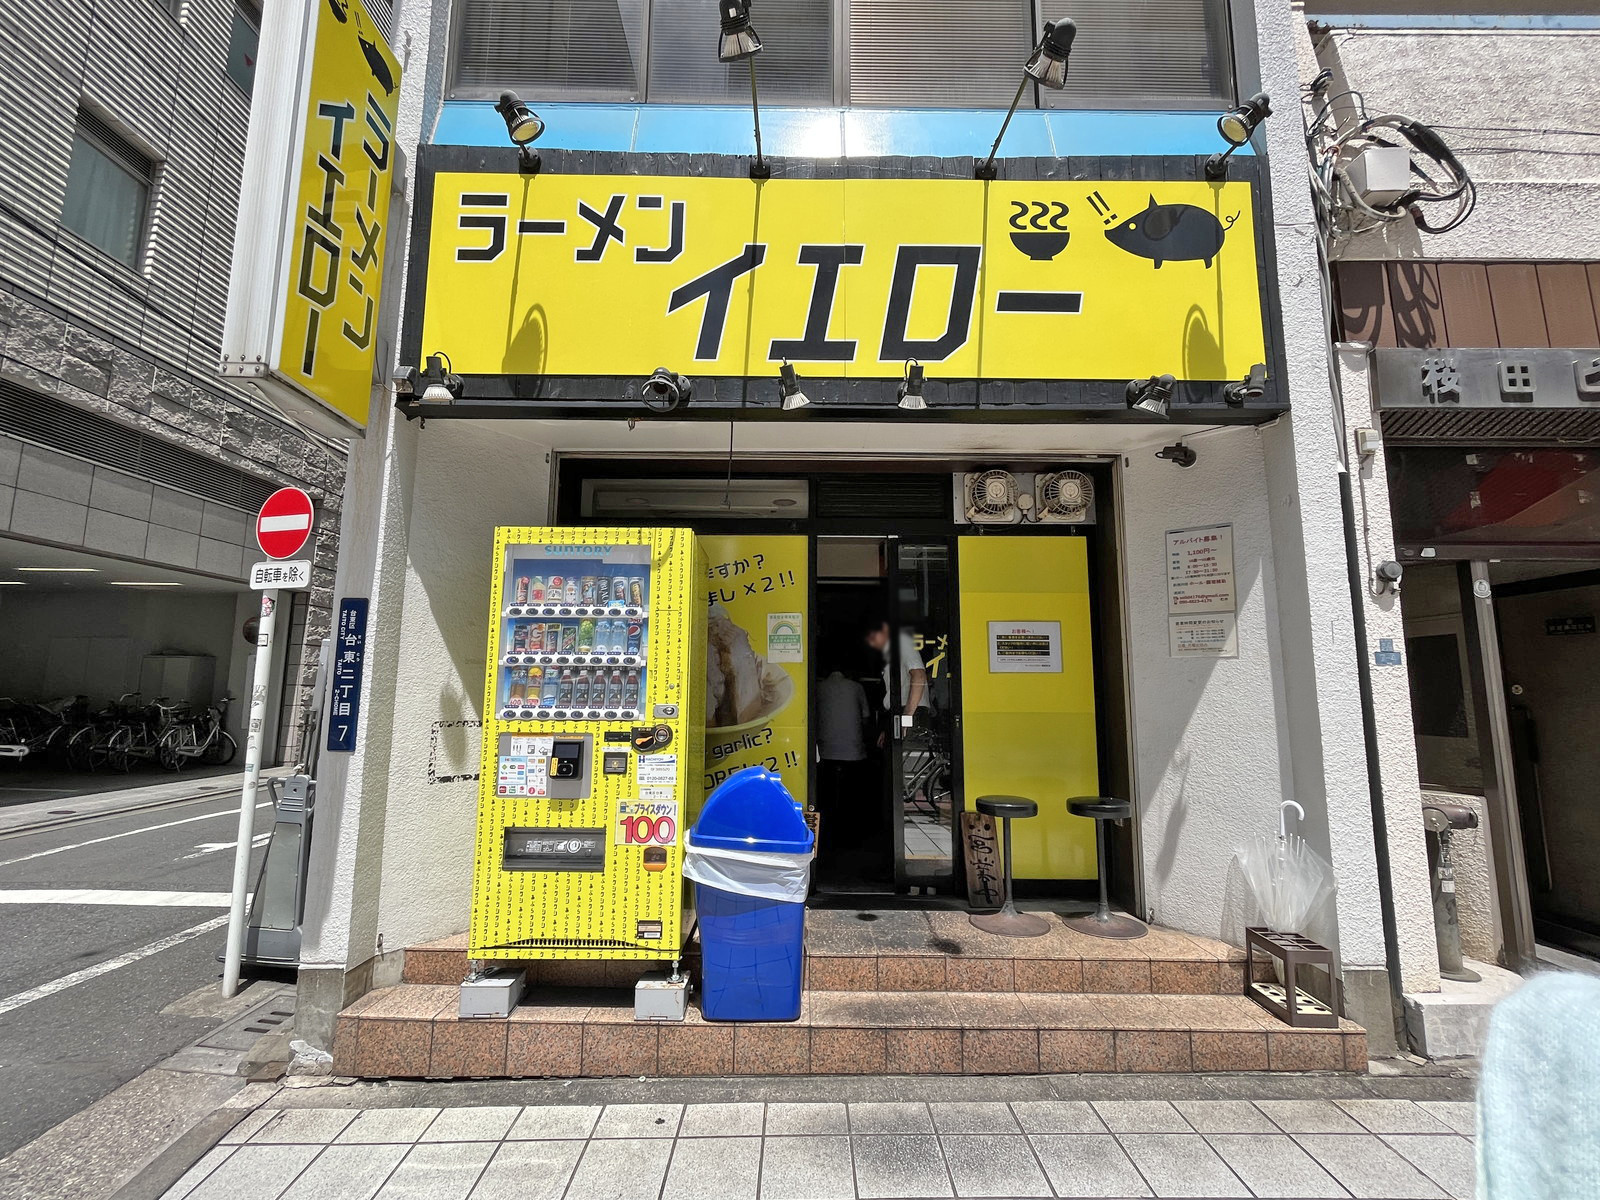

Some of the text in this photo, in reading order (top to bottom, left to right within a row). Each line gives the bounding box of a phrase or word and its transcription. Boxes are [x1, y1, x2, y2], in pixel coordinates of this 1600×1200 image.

[343, 89, 391, 351] ラーメン
[455, 192, 686, 264] ラーメン
[296, 99, 355, 377] イエロー
[667, 243, 1084, 363] イエロー
[544, 545, 612, 556] SUNTORY
[255, 566, 304, 583] 自転車を除く
[926, 652, 951, 679] イ
[332, 689, 340, 716] 2-CHOME
[338, 725, 348, 741] 7
[712, 728, 773, 760] garlic?
[620, 816, 676, 844] 100
